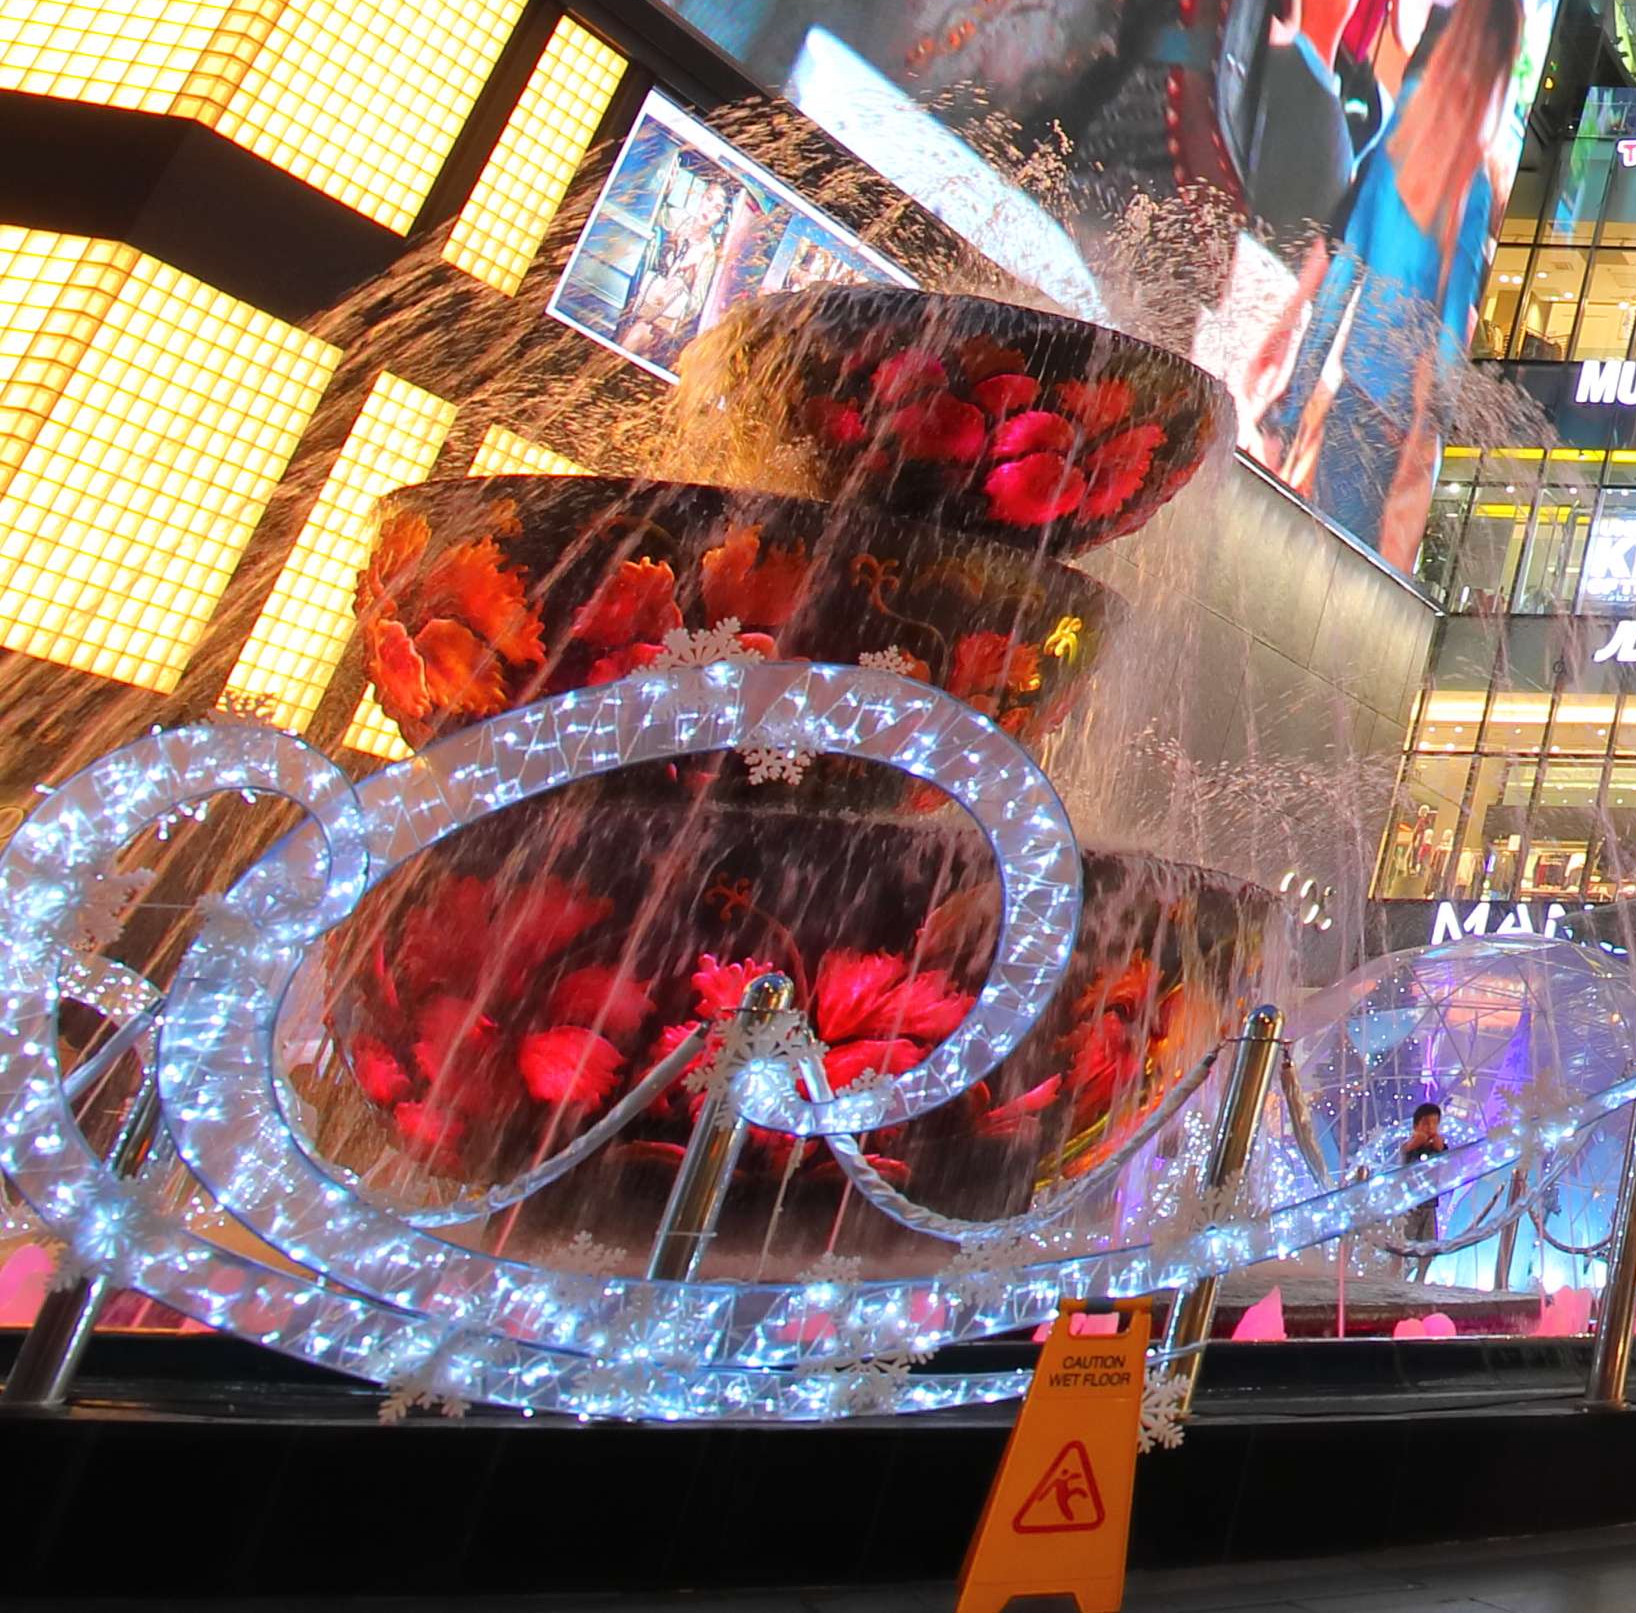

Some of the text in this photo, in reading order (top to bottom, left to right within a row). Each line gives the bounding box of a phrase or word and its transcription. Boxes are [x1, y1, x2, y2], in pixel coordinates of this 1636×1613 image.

[1062, 1354, 1127, 1370] CAUTION
[1048, 1371, 1132, 1387] WET FLOOR
